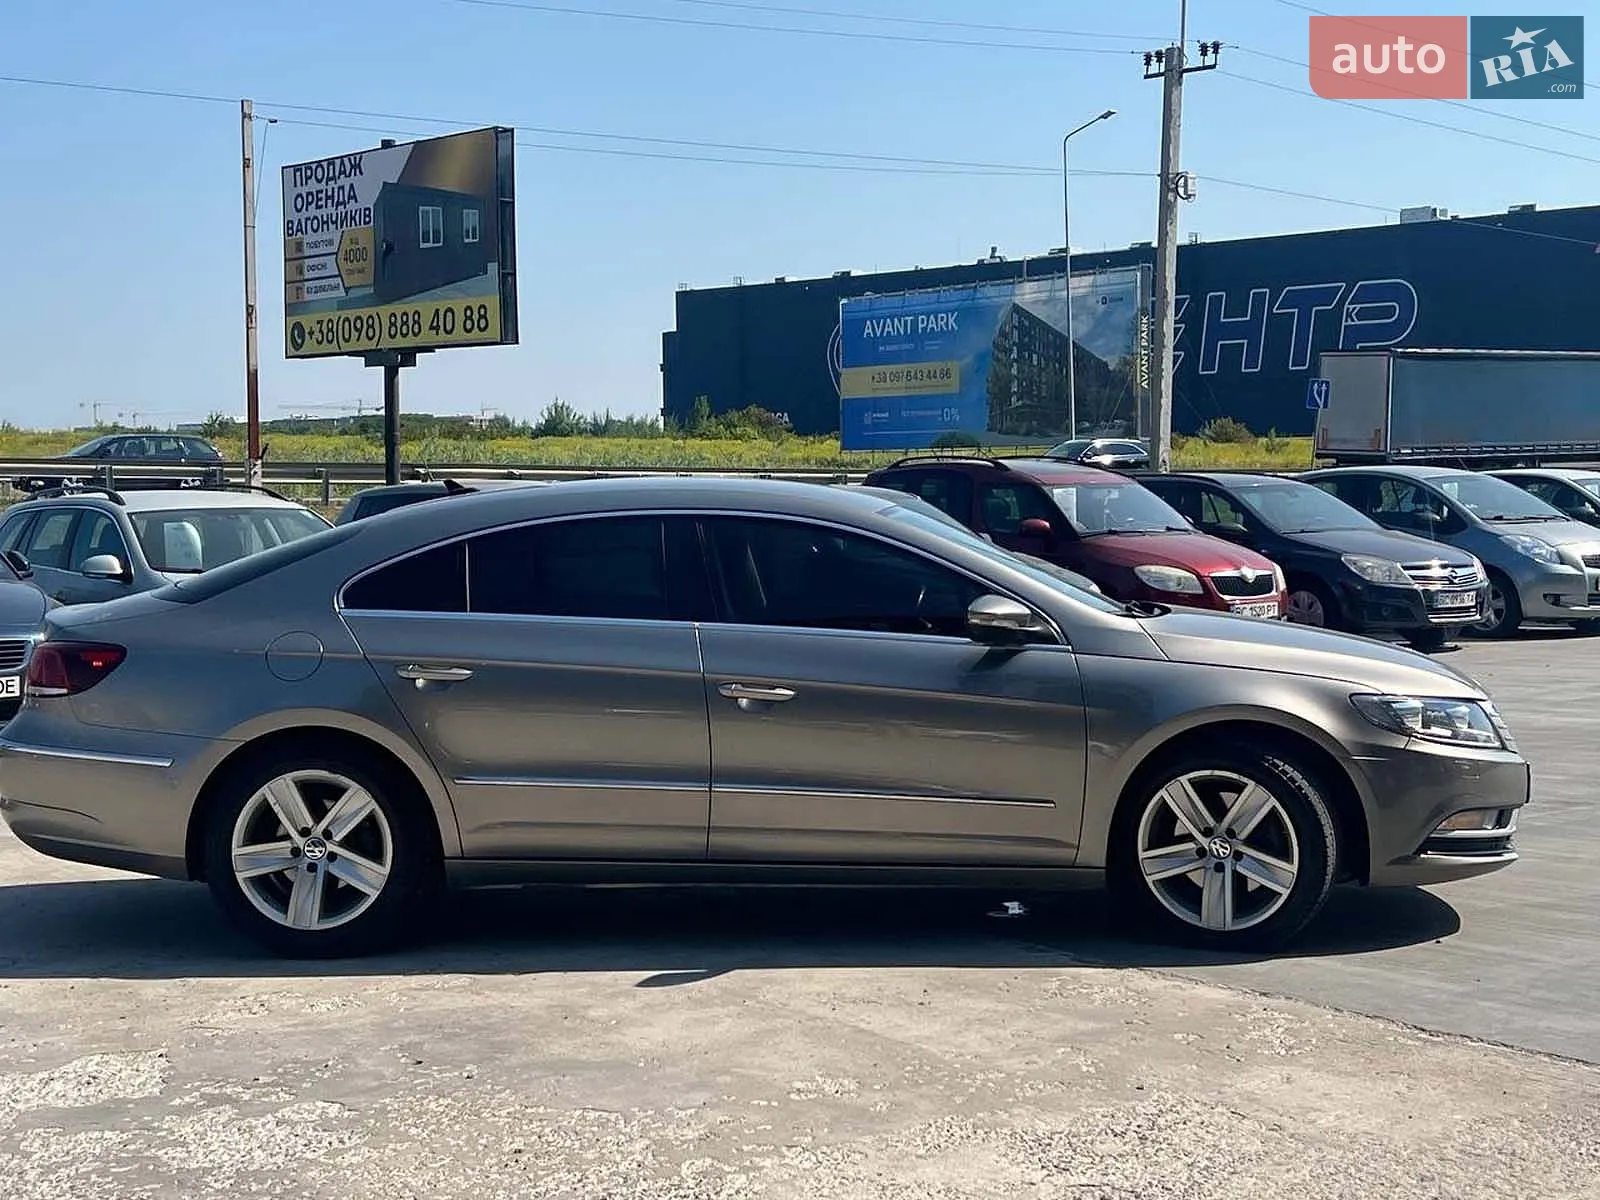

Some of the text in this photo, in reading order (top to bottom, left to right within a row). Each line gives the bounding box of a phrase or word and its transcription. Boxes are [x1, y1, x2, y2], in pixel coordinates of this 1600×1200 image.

[293, 155, 363, 188] ПРОДАЖ
[294, 182, 358, 213] ОРЕНДА
[286, 207, 372, 237] ВАГОНЧИКІВ
[343, 246, 368, 264] 4000
[307, 304, 489, 350] +38(098) 888 40 88
[864, 312, 958, 338] AVANT PARK
[1140, 314, 1150, 389] AVANT PARK
